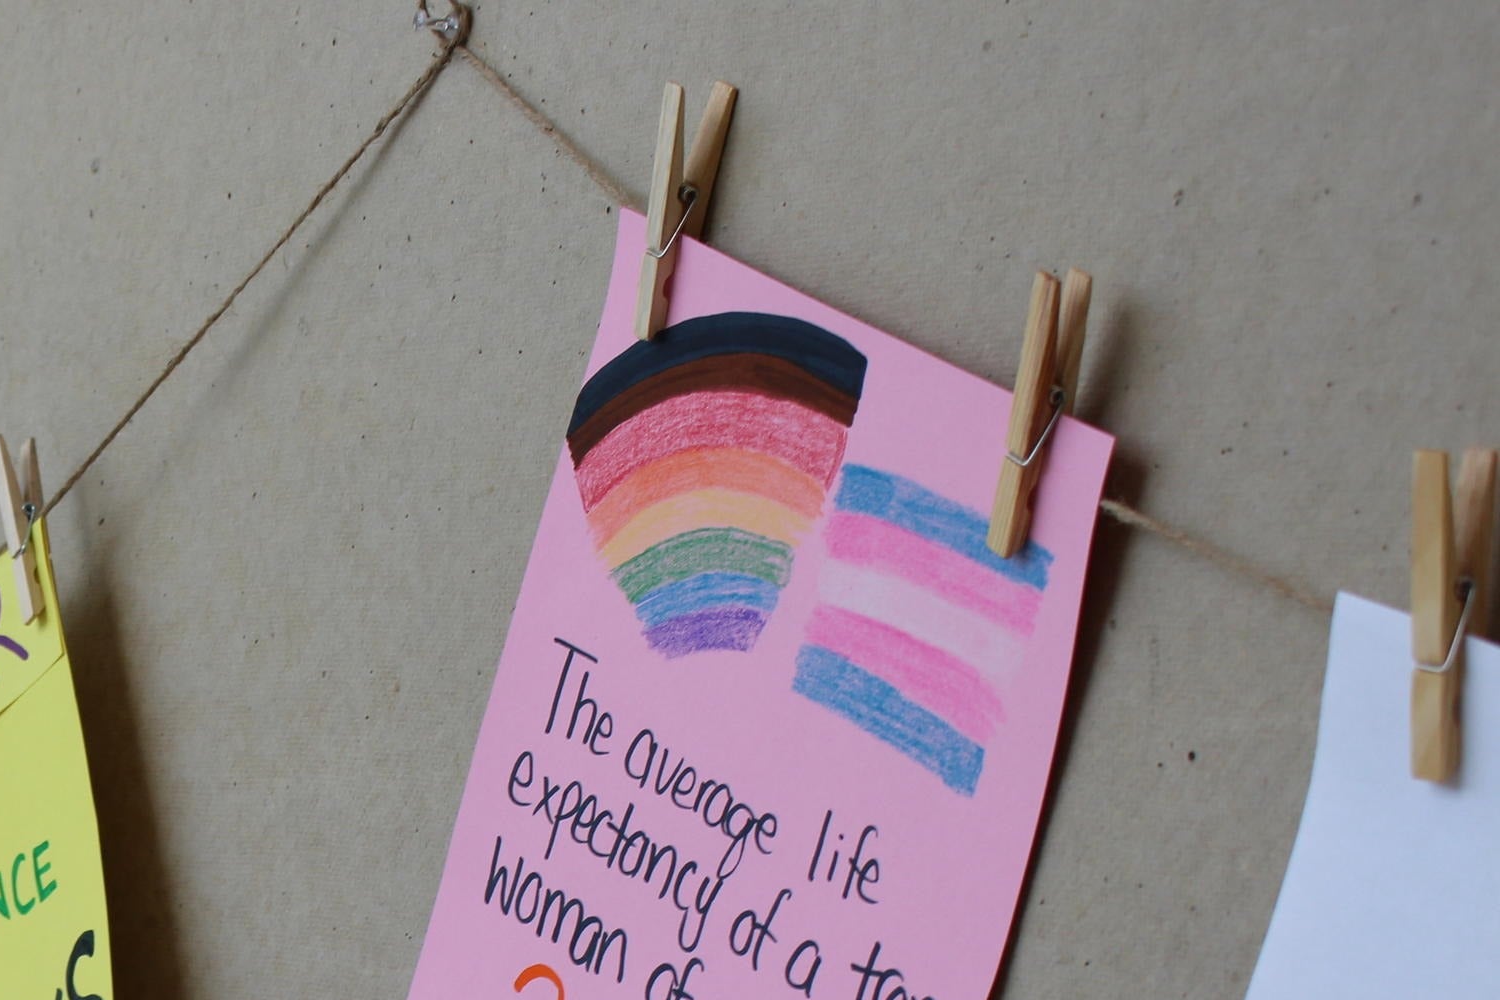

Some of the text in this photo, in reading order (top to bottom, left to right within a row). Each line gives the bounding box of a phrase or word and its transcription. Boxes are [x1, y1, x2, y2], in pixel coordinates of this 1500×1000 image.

[507, 749, 723, 952] expectancy
[729, 888, 791, 971] of
[785, 939, 818, 998] a
[544, 638, 881, 904] The average life
